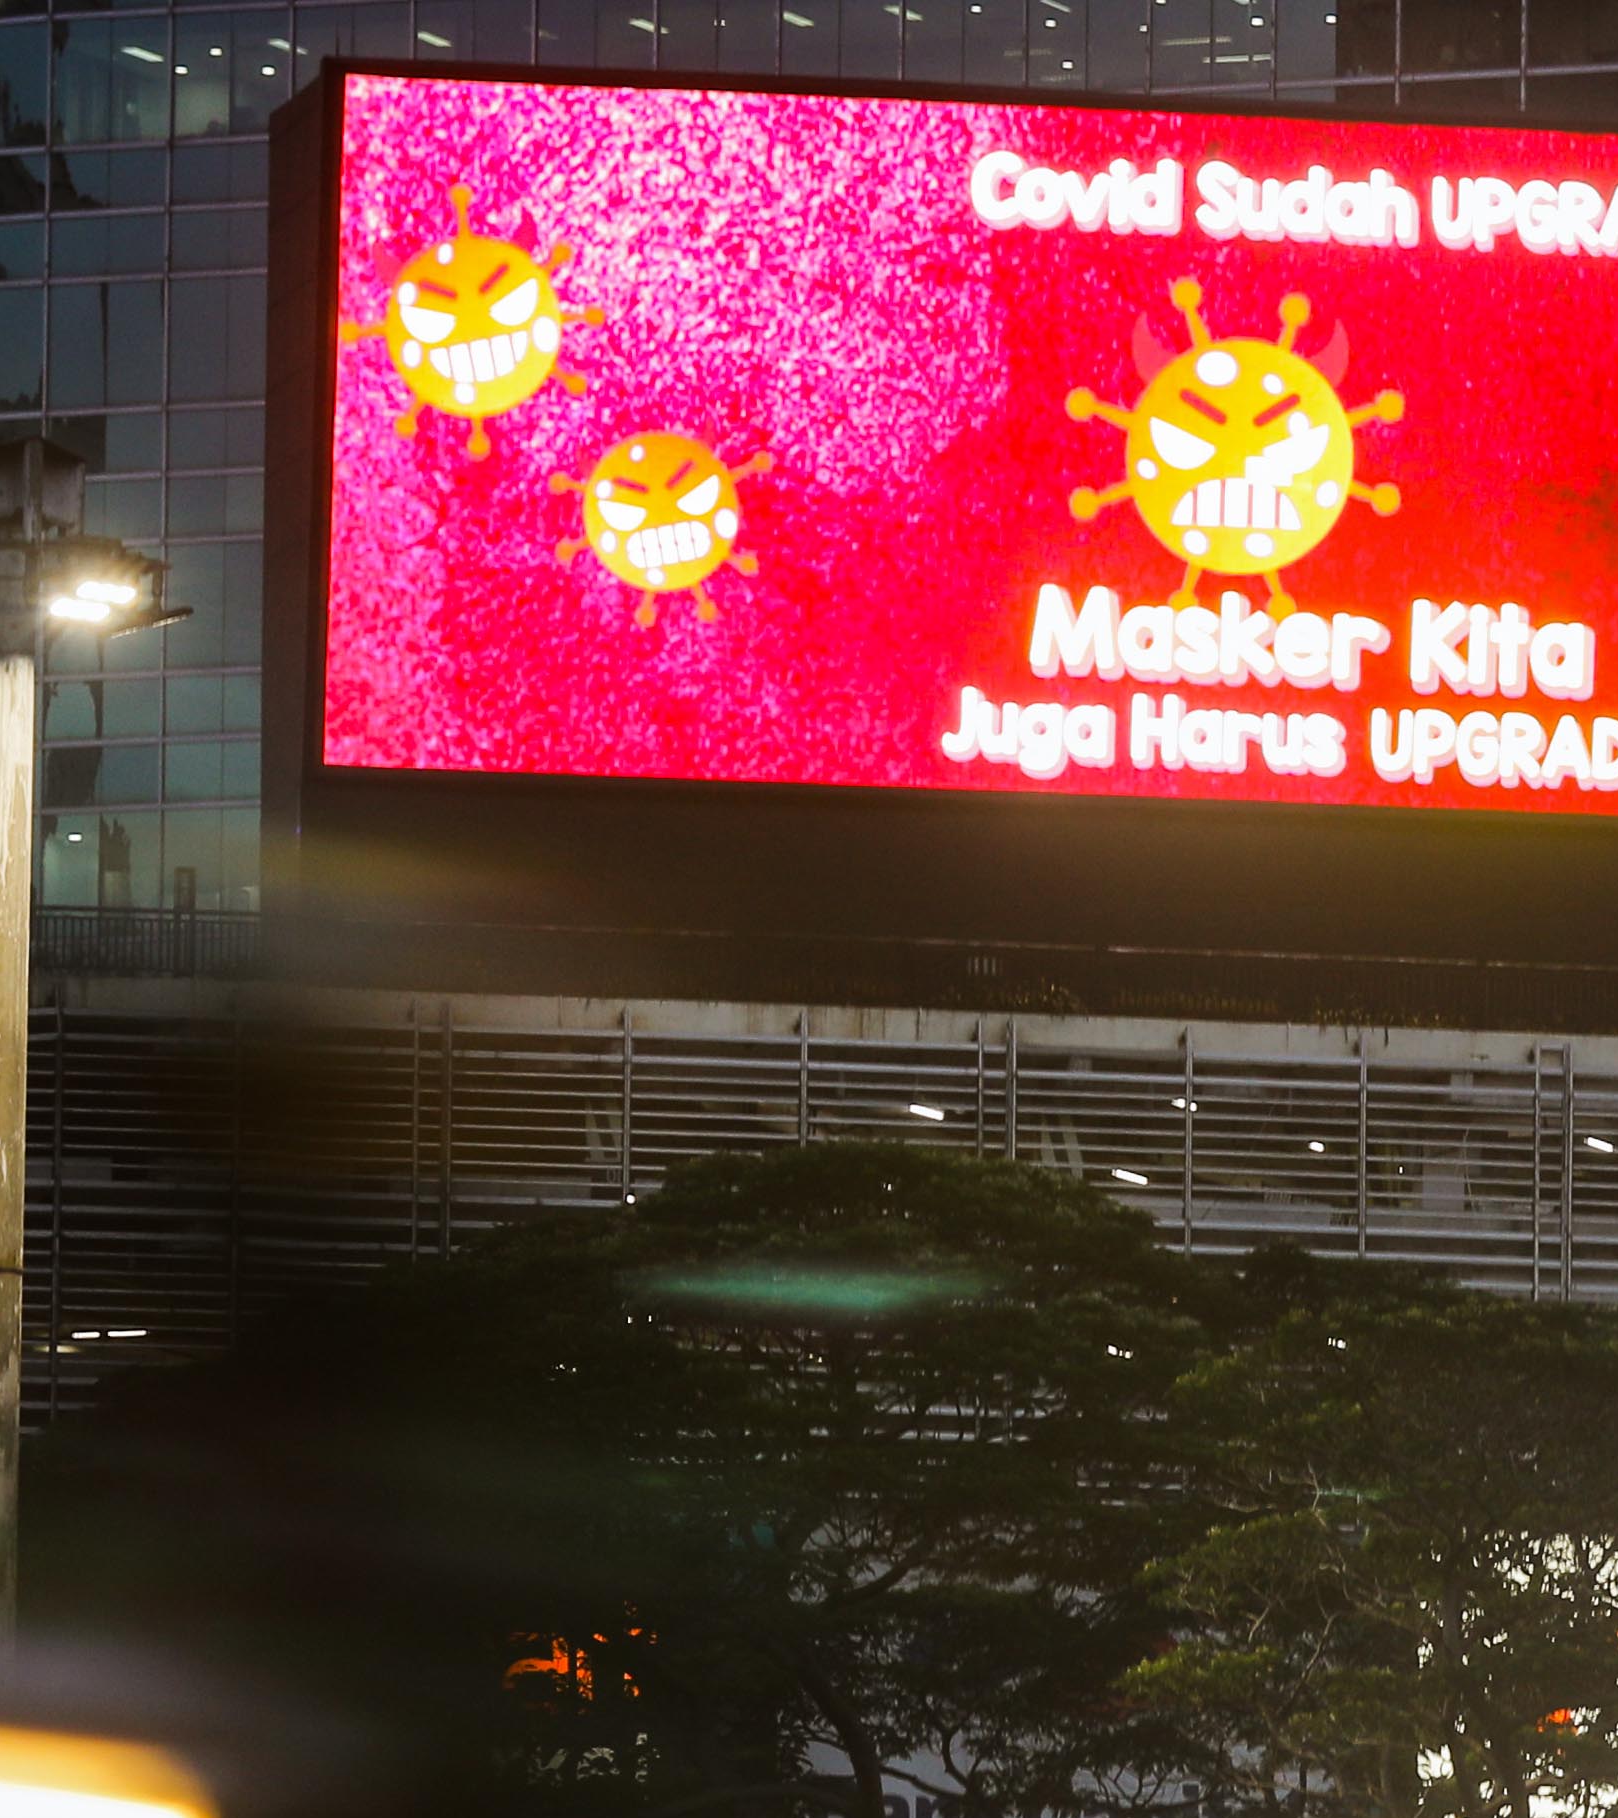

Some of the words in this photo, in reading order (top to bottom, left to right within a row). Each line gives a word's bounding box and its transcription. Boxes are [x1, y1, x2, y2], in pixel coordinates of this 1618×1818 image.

[971, 150, 1185, 236] Covid
[1194, 160, 1420, 248] Sudah
[1029, 583, 1391, 693] Masker
[1410, 598, 1595, 702] Kita
[942, 686, 1116, 779] Juga
[1129, 693, 1347, 778] Harus
